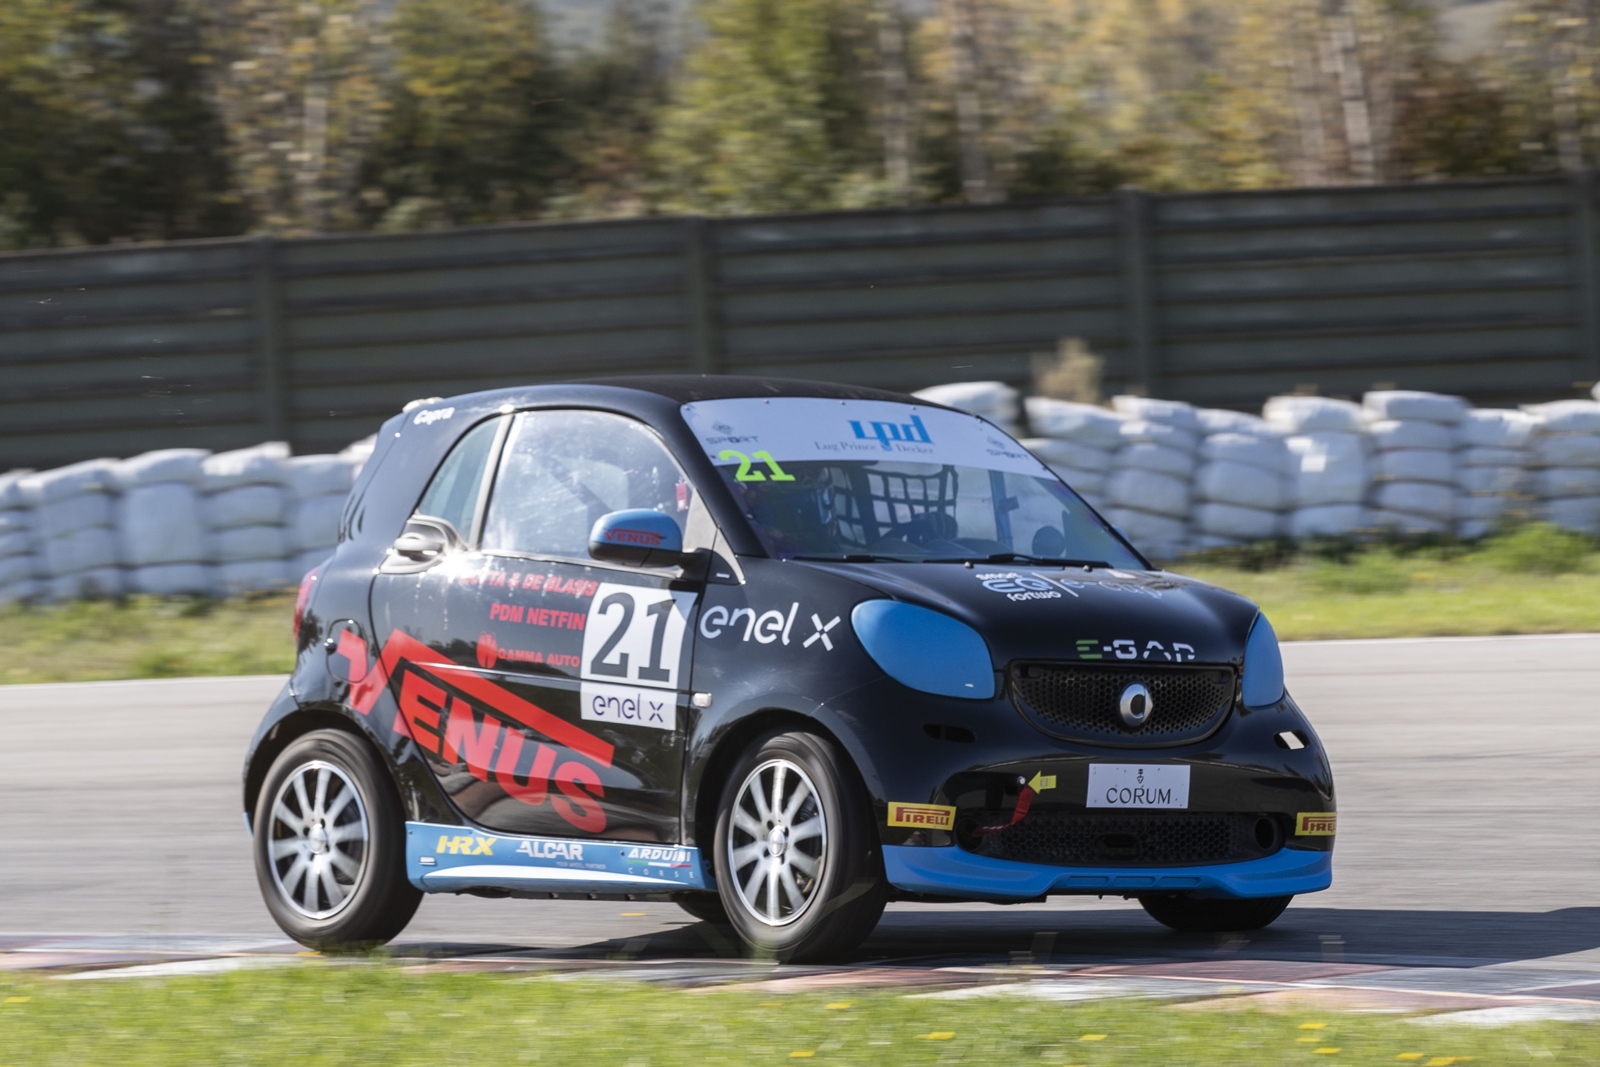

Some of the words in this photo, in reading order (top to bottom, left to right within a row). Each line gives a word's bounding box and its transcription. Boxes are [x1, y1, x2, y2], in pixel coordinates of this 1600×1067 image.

[840, 441, 877, 451] Prince
[719, 450, 796, 482] 21
[604, 528, 662, 546] VENUS
[522, 573, 545, 590] DE
[982, 577, 1053, 593] EQ
[1006, 590, 1062, 602] fortwo
[490, 603, 523, 624] PDM
[526, 608, 586, 631] NETFIN
[700, 602, 799, 646] enel
[590, 592, 677, 683] 21
[497, 647, 543, 664] GAMMA
[546, 654, 580, 668] AUTO
[592, 693, 642, 720] enel
[336, 628, 614, 833] VENUS
[1106, 787, 1172, 805] CORUM
[895, 806, 951, 826] PIRELLI
[1302, 816, 1337, 831] PIRE
[436, 835, 497, 856] HRX
[515, 840, 584, 861] ALCAR
[627, 848, 691, 862] ARDUINI
[628, 867, 694, 879] CORSE
